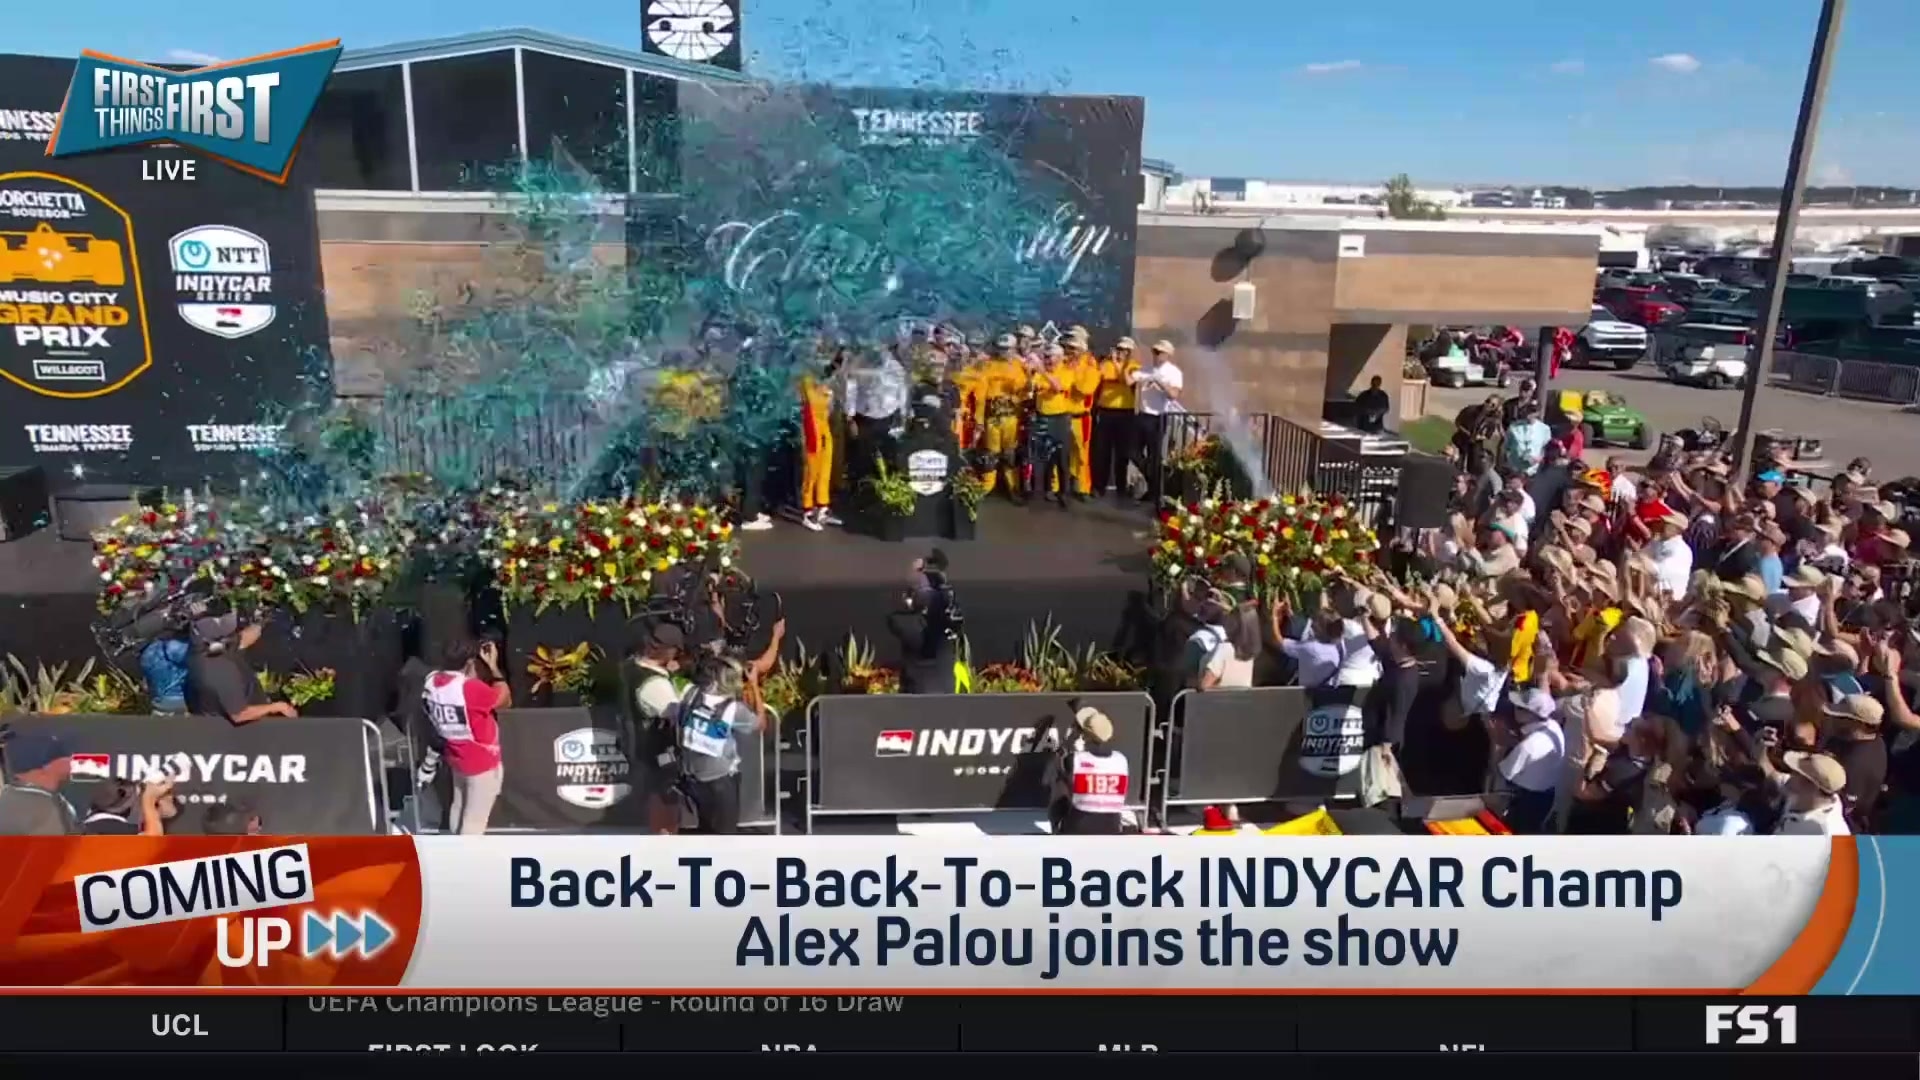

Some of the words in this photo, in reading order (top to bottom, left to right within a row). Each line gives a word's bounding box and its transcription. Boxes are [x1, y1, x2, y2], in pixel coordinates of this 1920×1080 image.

[0, 189, 86, 212] ORCHETTA
[216, 246, 260, 264] NTT
[176, 274, 272, 293] INDYCAR
[0, 289, 65, 304] MUSIC
[68, 291, 118, 304] CITY
[0, 303, 129, 326] GRAND
[15, 325, 112, 348] PRIX
[24, 424, 134, 443] TENNESSEE
[916, 727, 1084, 757] INDYCA
